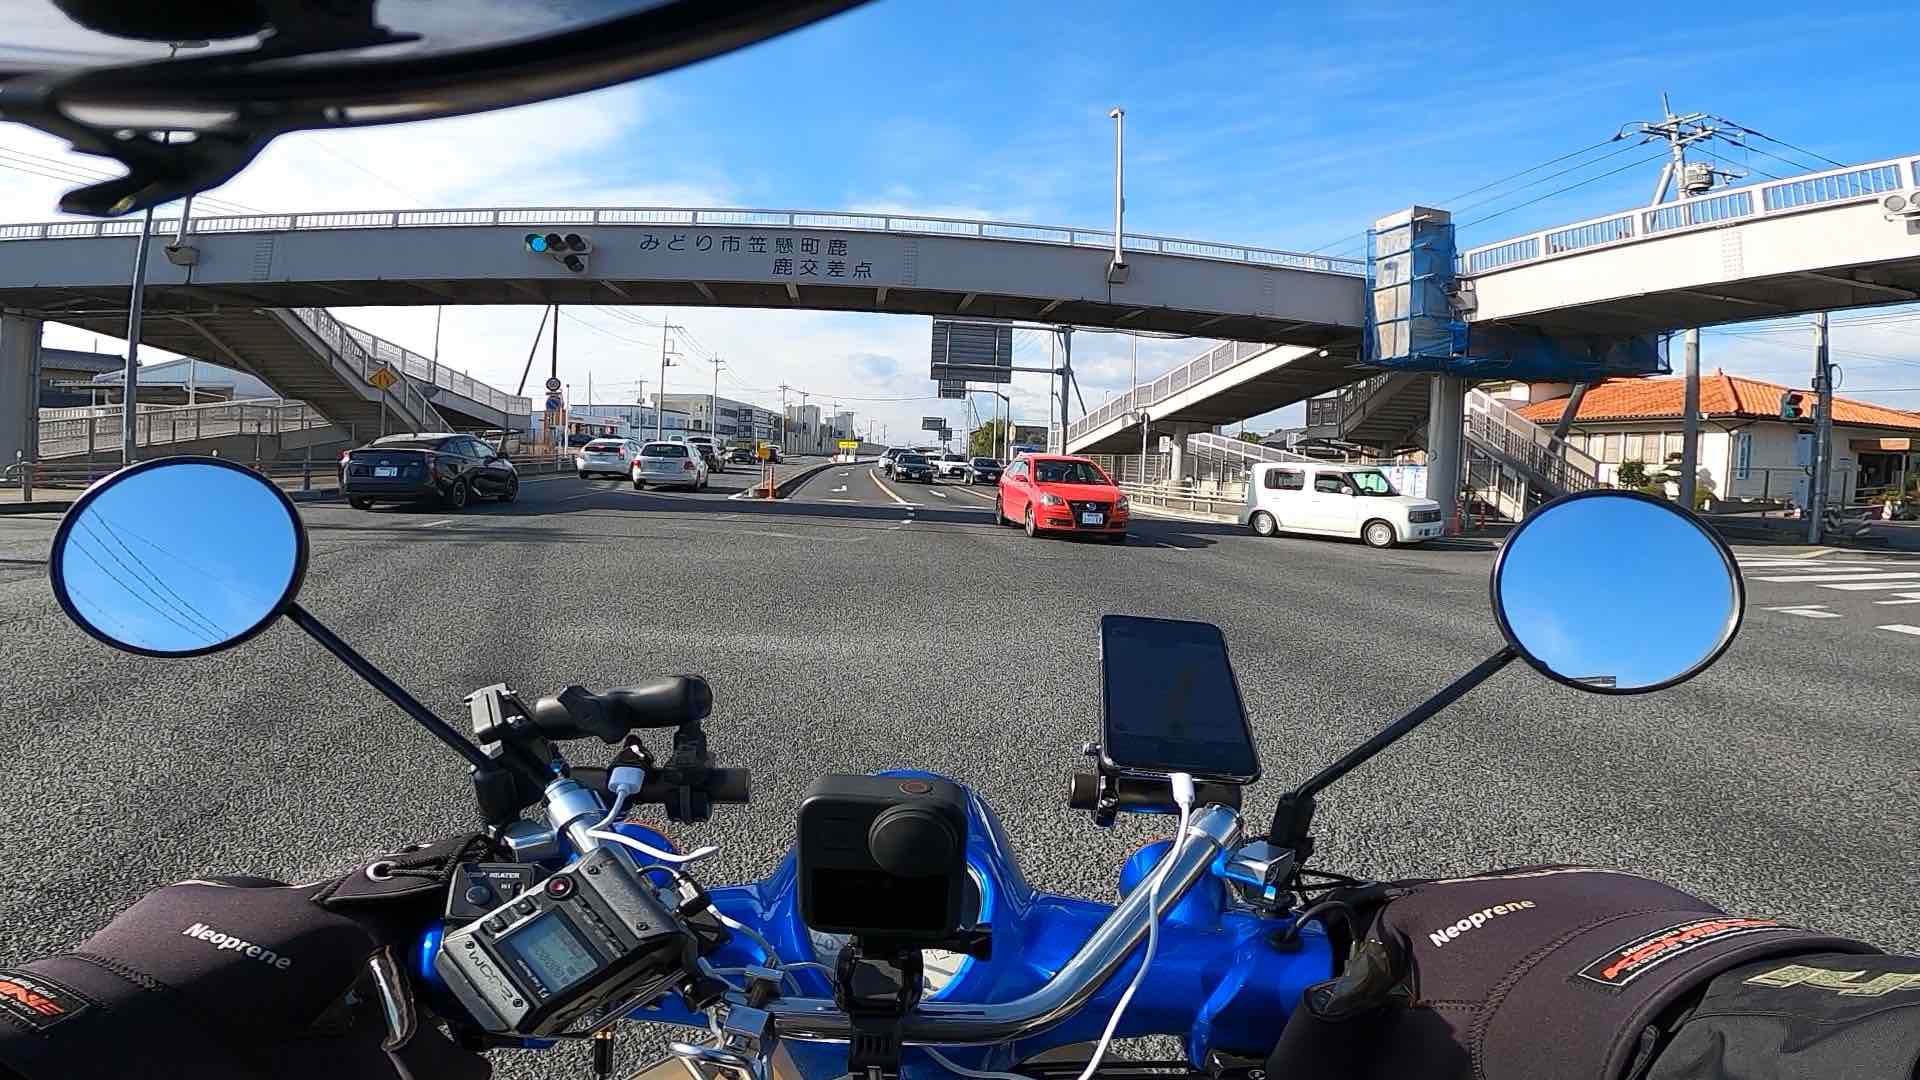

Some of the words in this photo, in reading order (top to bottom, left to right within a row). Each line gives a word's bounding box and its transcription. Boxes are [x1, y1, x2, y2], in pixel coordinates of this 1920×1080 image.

[639, 234, 848, 256] みどり市笠懸町鹿
[772, 258, 873, 279] 鹿交差点
[1429, 900, 1537, 947] Neoprene
[182, 923, 291, 969] Neoprene
